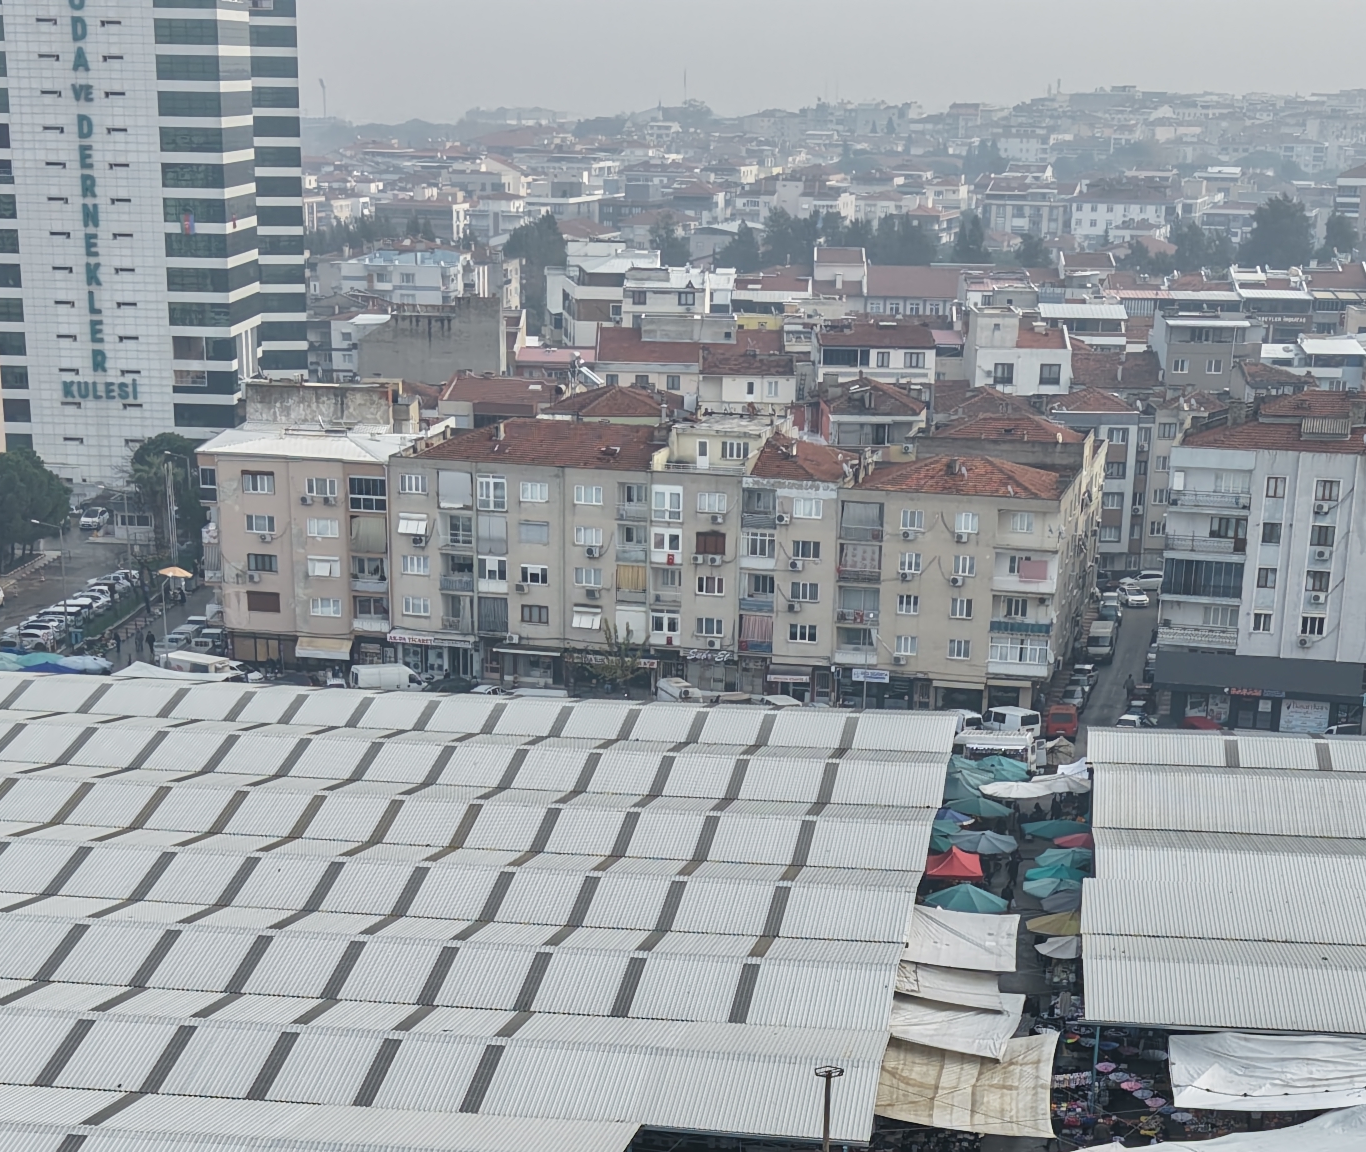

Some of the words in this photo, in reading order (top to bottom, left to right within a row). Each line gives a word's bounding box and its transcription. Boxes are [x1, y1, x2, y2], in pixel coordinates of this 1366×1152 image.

[71, 84, 94, 102] VE
[77, 114, 107, 372] DERNEKLER
[62, 379, 138, 400] KULESİ
